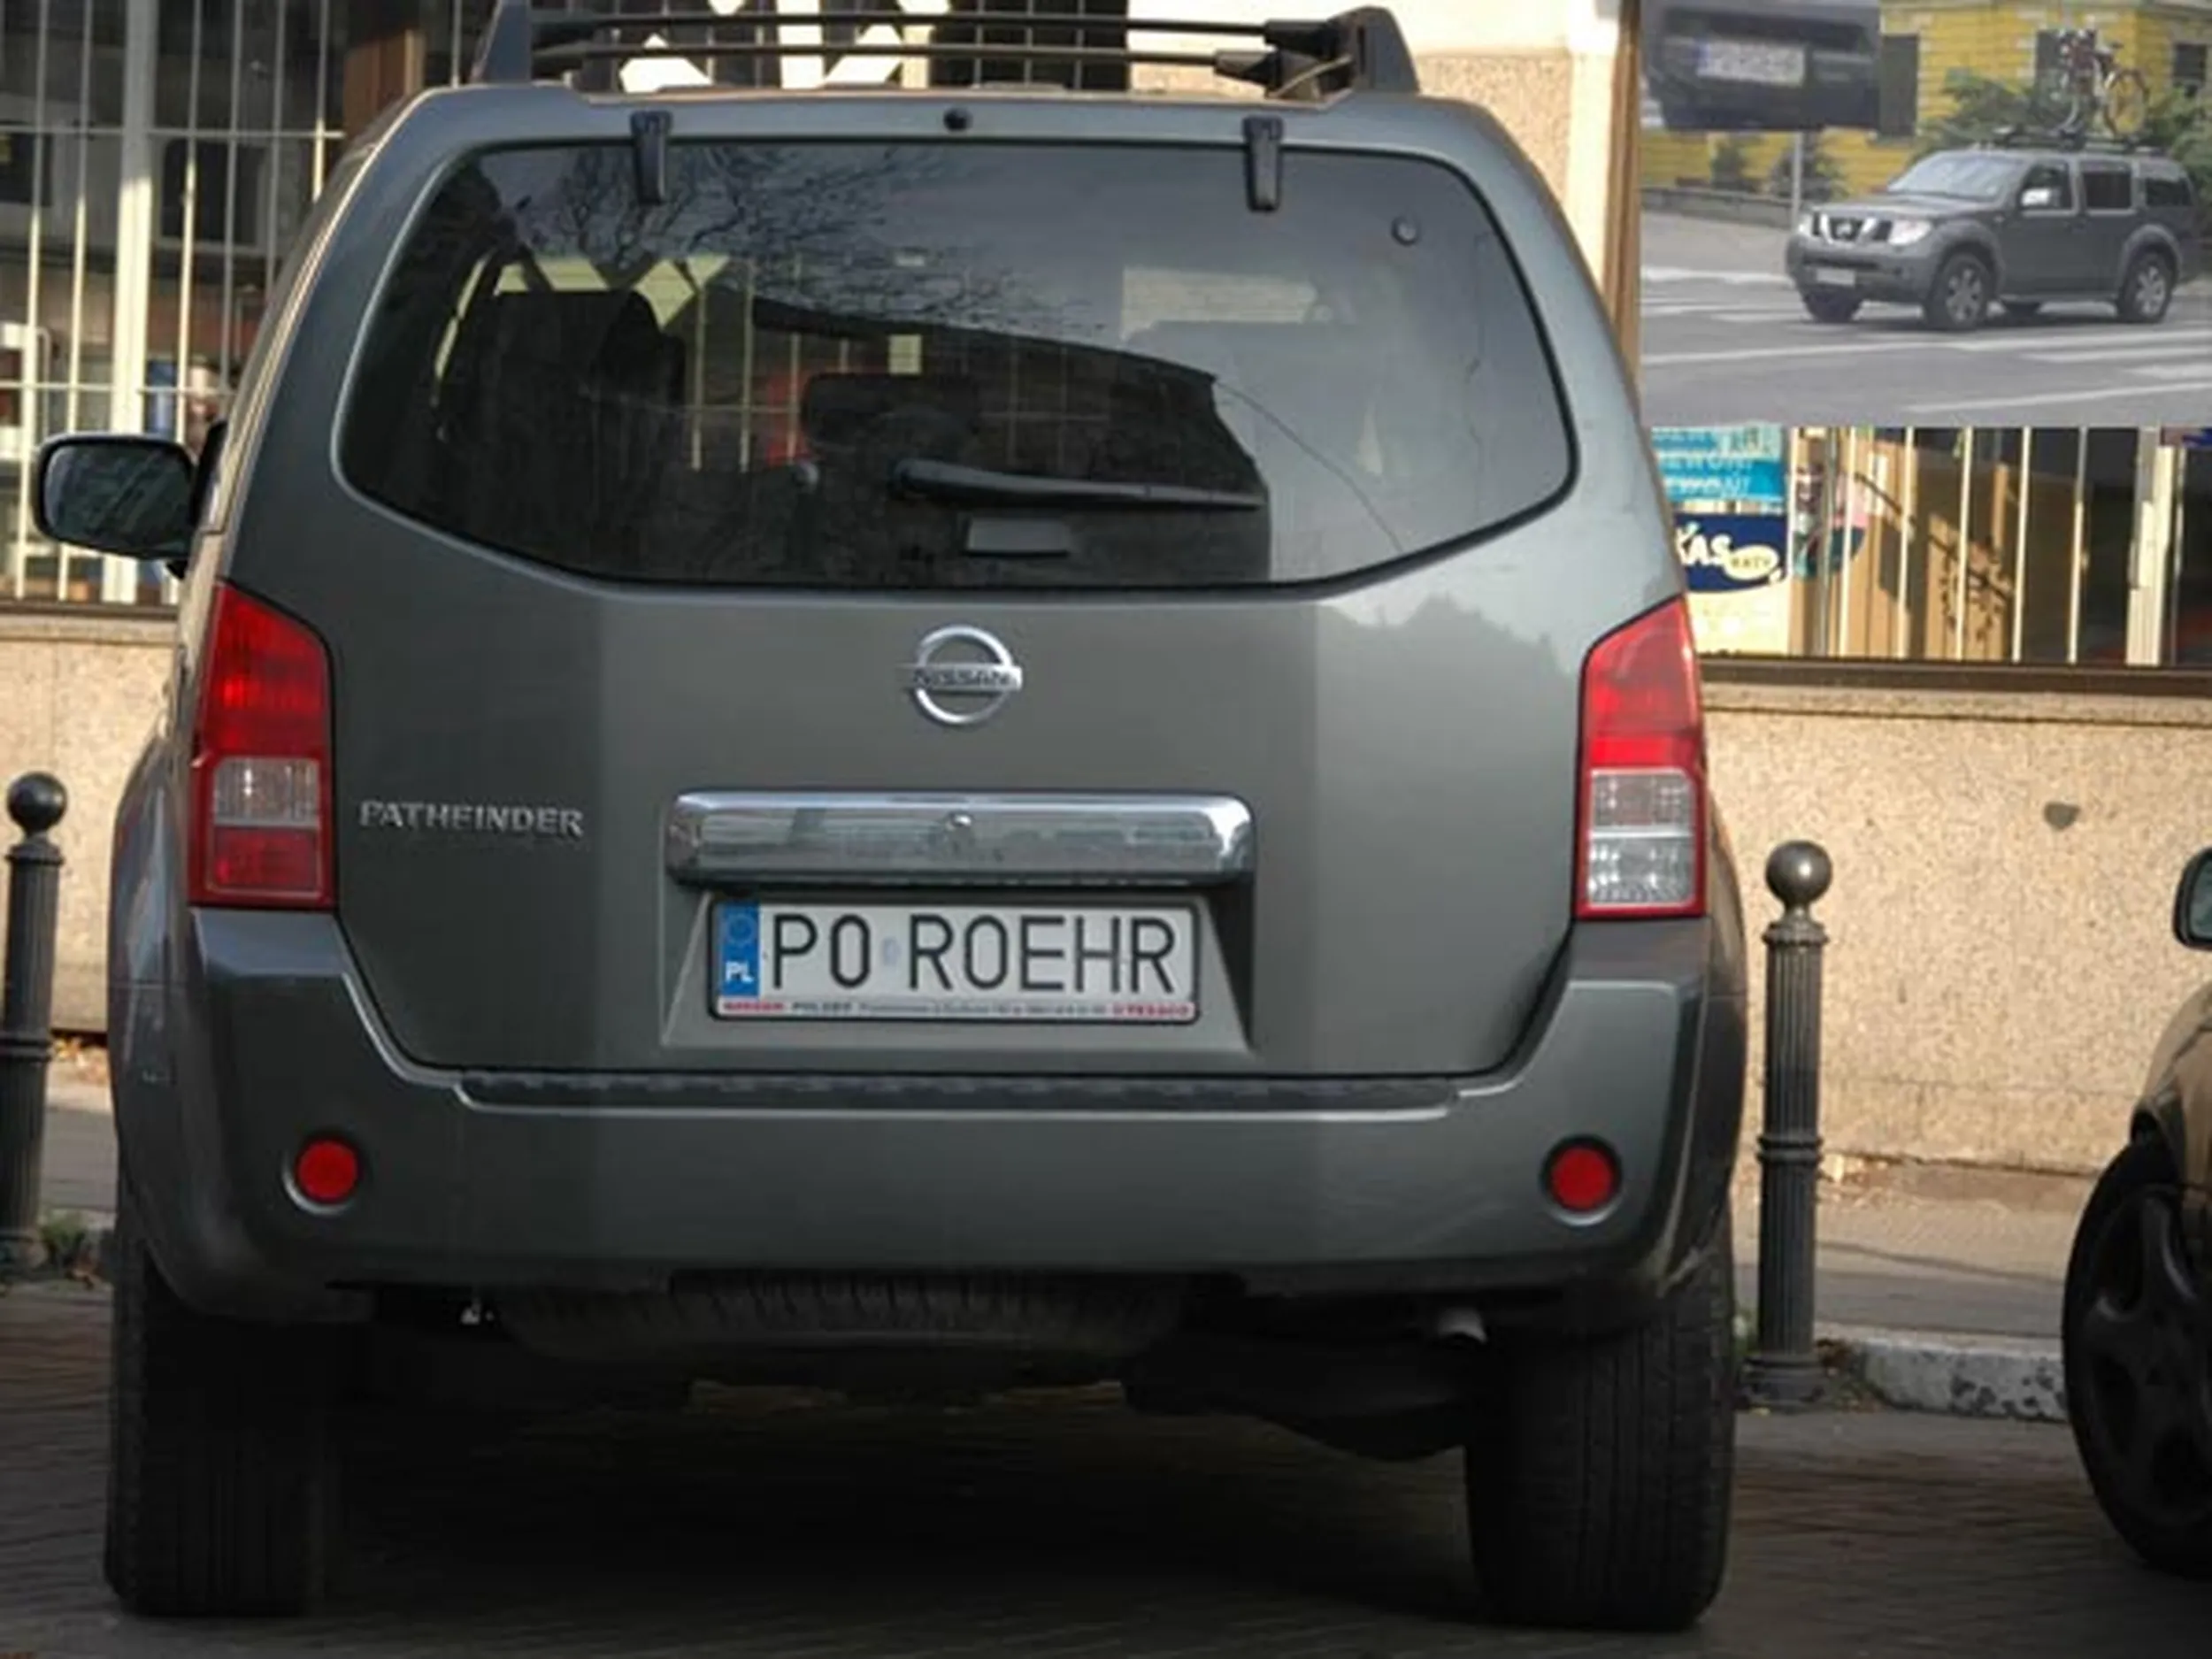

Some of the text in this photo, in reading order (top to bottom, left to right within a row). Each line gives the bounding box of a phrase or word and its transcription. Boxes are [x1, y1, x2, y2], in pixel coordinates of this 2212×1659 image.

[358, 800, 584, 837] PATHFINDER
[725, 960, 754, 983] PL
[910, 914, 1175, 993] ROEHR
